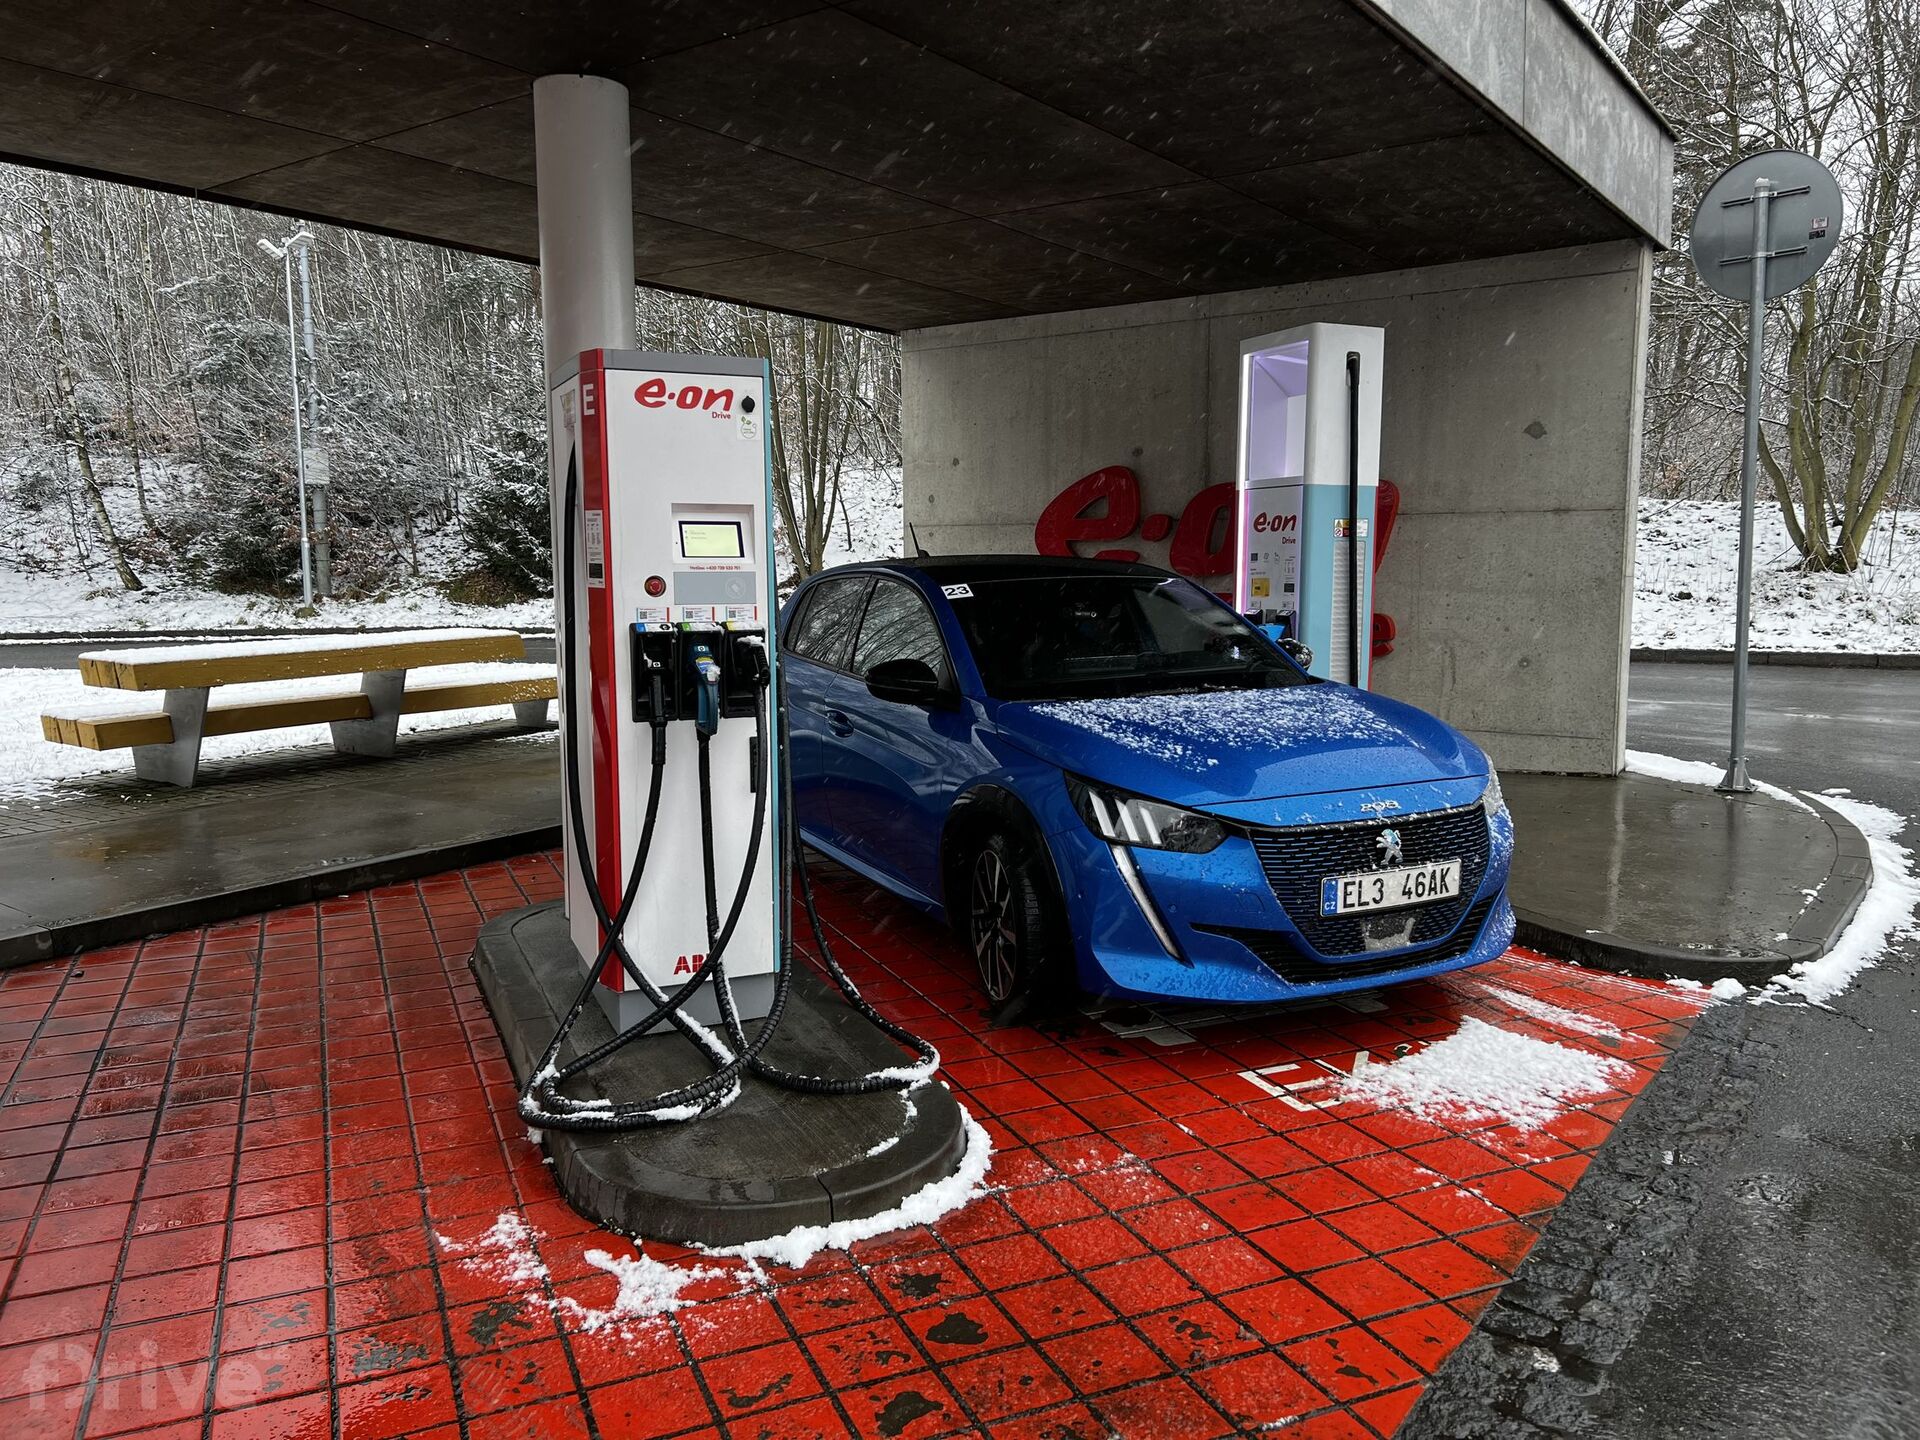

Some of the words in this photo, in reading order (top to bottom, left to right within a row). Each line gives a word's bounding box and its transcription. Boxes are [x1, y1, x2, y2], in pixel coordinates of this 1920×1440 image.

[582, 383, 596, 416] E
[711, 411, 732, 420] Drive
[1281, 536, 1297, 545] Drive
[944, 586, 970, 596] 23
[1360, 801, 1399, 812] 208
[1343, 878, 1384, 908] EL3
[1402, 867, 1450, 899] 46AK
[1324, 901, 1336, 910] CZ
[673, 954, 709, 975] AB
